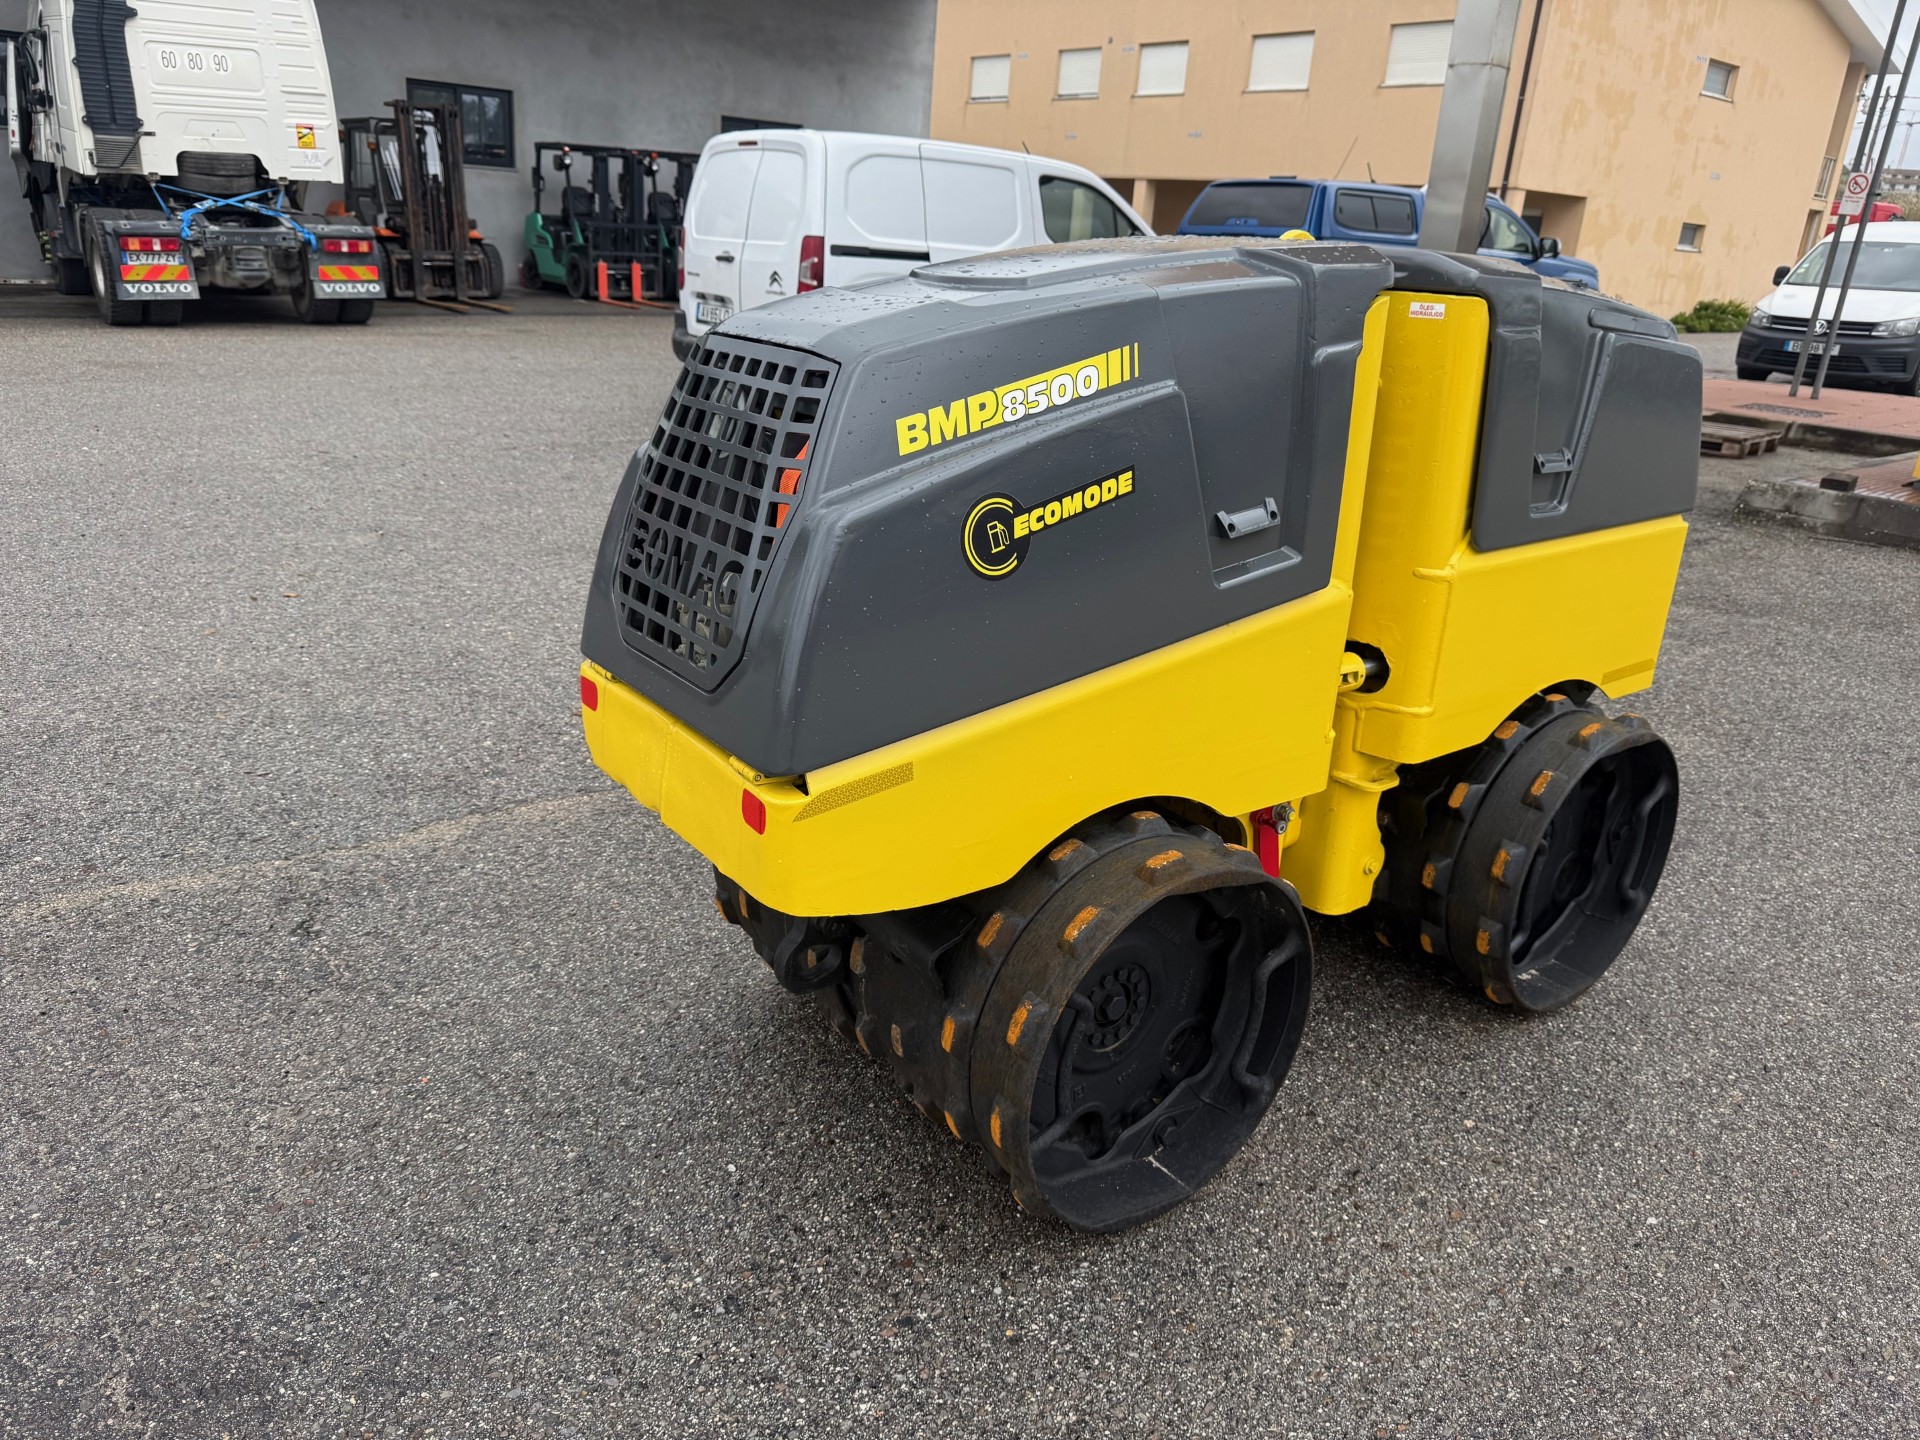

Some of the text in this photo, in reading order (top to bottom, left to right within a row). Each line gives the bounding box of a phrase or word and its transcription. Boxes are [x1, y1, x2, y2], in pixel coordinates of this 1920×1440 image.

[161, 50, 229, 72] 60 80 90
[122, 283, 192, 294] VOLVO
[320, 283, 381, 293] VOLVO
[1419, 303, 1435, 311] ÓLEO
[1410, 310, 1444, 318] HIDRÁULICO
[1014, 470, 1133, 539] ECOMODE
[624, 517, 745, 618] BOMAG
